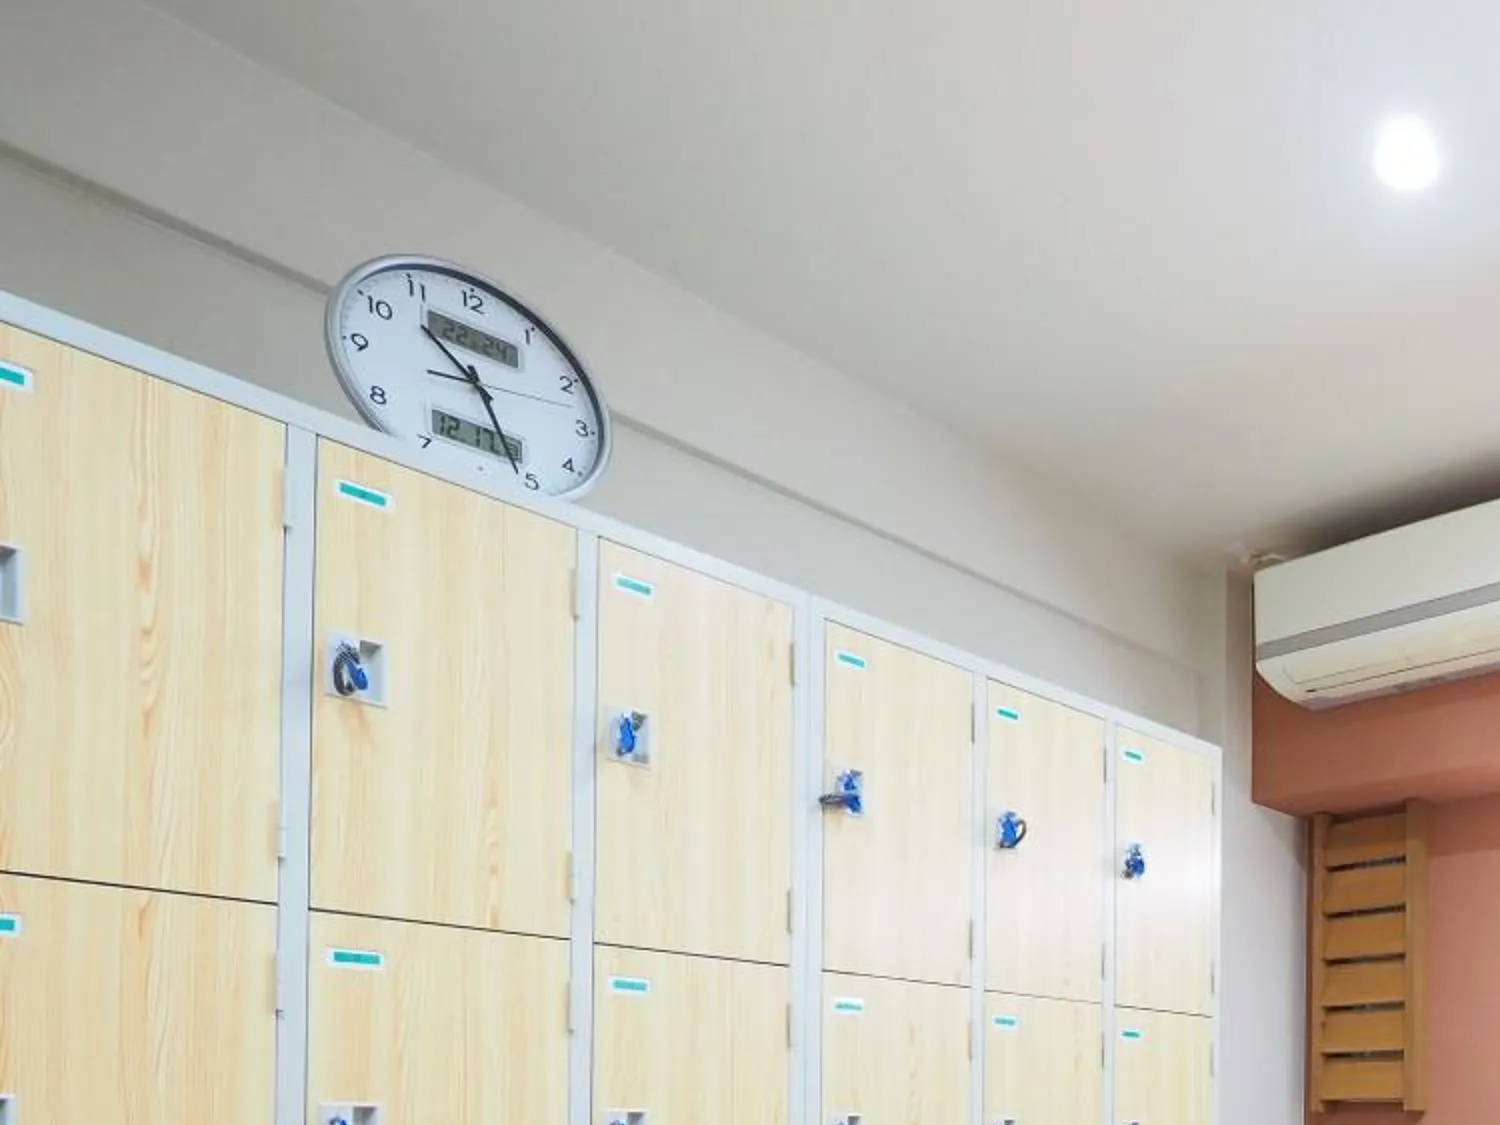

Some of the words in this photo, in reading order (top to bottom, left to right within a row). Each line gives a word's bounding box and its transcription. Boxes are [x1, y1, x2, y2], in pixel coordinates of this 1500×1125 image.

[408, 277, 426, 302] 11
[367, 295, 393, 321] 10
[462, 290, 485, 315] 12
[350, 333, 369, 351] 9
[560, 376, 575, 394] 2
[369, 386, 387, 405] 8
[575, 420, 589, 437] 3
[417, 434, 432, 448] 7
[562, 457, 575, 473] 4
[525, 473, 540, 491] 5
